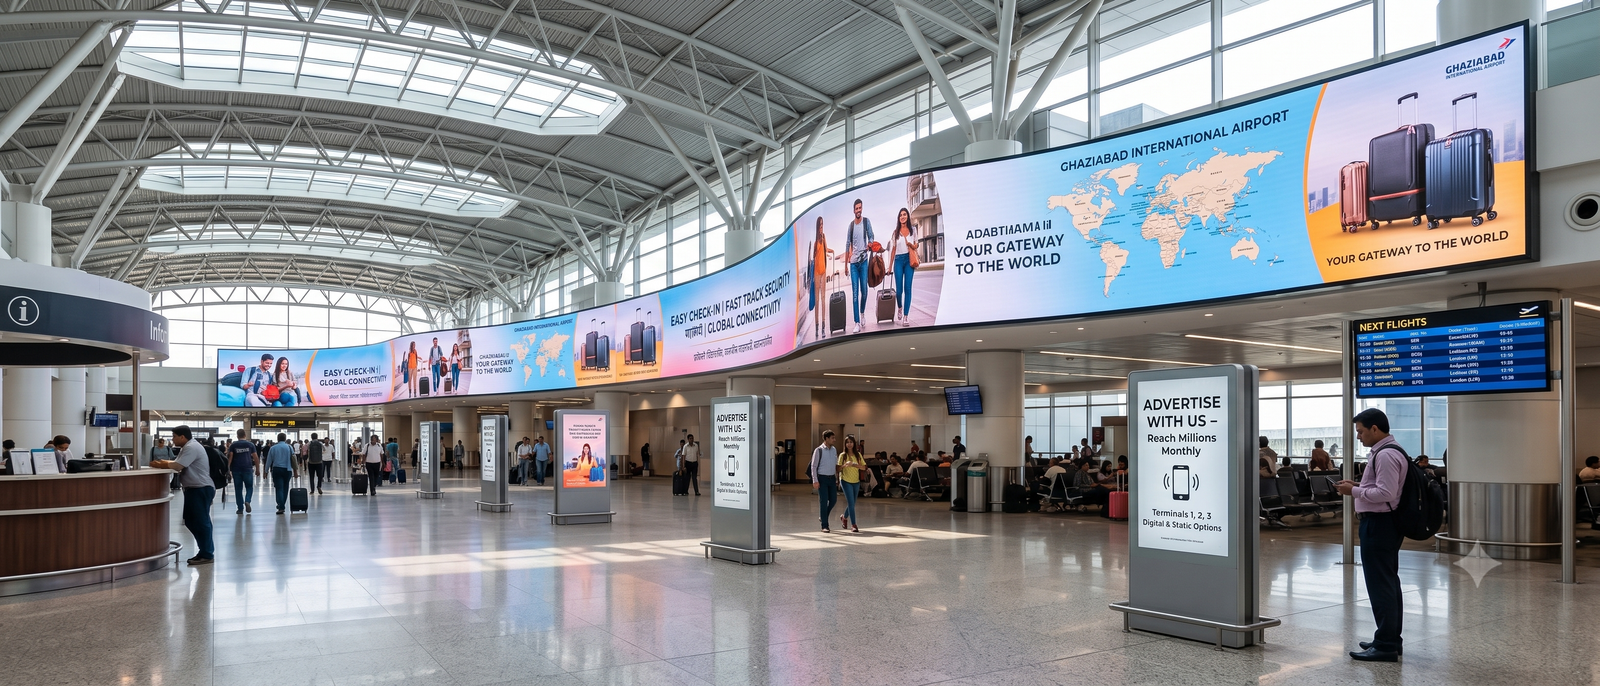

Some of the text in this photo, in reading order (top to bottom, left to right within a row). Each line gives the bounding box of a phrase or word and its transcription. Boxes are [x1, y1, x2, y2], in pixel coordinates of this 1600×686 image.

[1446, 50, 1505, 74] GHAZIABAD
[1446, 60, 1506, 80] INTERNATIONAL AIRPORT
[1060, 110, 1290, 172] GHAZIABAD INTERNATIONAL AIRPORT
[954, 234, 1064, 258] YOUR GATEWAY
[1326, 230, 1509, 266] YOUR GATEWAY TO THE WORLD
[956, 253, 1061, 275] TO THE WORLD
[670, 314, 689, 326] EASY
[689, 303, 721, 321] CHECK-IN
[725, 296, 741, 312] FAST
[743, 286, 764, 306] TRACK
[764, 270, 791, 296] SECURITY
[708, 317, 734, 334] GLOBAL
[736, 298, 781, 327] CONNECTIVITY
[1360, 318, 1427, 331] NEXT FLIGHTS
[324, 369, 342, 377] EASY
[344, 366, 375, 376] CHECK-IN
[348, 375, 387, 385] CONNECTIVITY
[1143, 396, 1221, 411] ADVERTISE
[717, 413, 747, 422] ADVERTISE
[1147, 415, 1183, 428] WITH
[1187, 414, 1206, 427] US
[1147, 433, 1217, 443] Reach Millions
[1161, 446, 1201, 457] Monthly
[1152, 509, 1188, 518] Terminals
[1190, 511, 1196, 520] 1,
[1198, 512, 1204, 520] 2,
[1143, 519, 1164, 529] Digital
[1172, 521, 1192, 530] Static
[1193, 523, 1222, 532] Options
